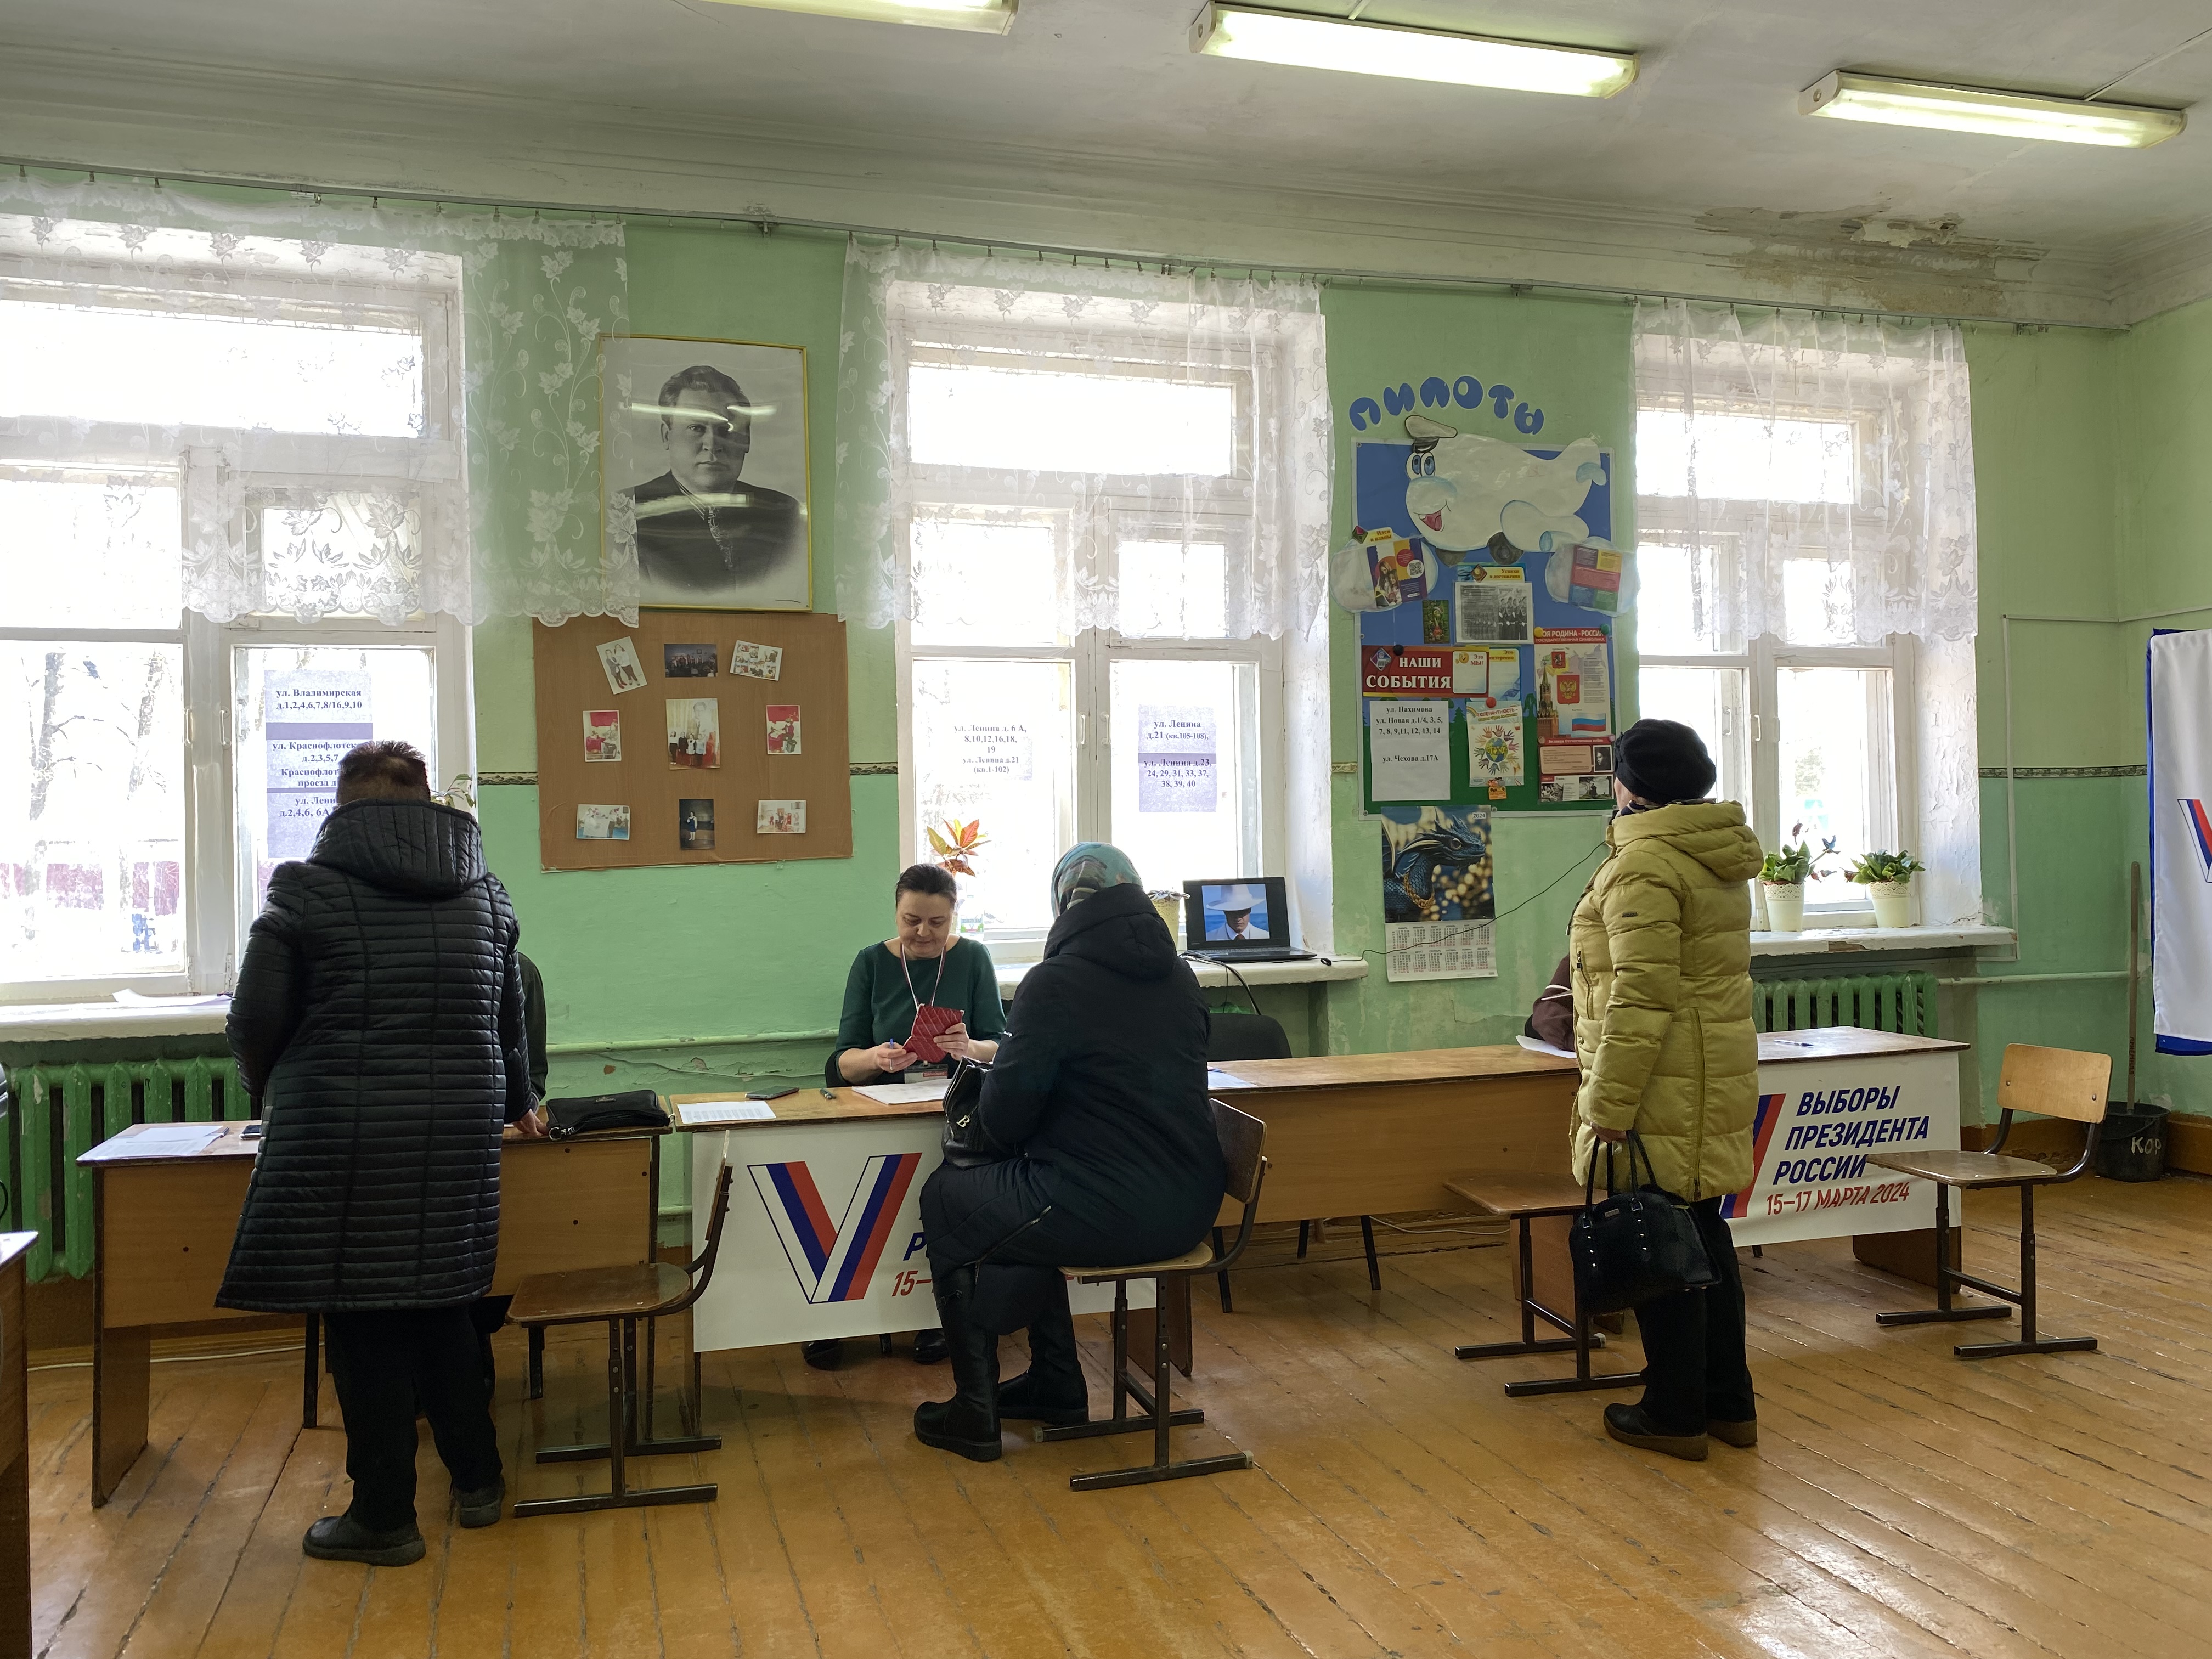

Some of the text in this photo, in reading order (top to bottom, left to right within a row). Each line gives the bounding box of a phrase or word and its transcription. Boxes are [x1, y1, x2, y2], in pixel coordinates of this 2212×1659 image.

[1348, 375, 1544, 435] ПИЛОТЫ
[1399, 657, 1441, 668] НАШИ
[1366, 675, 1451, 689] СОБЫТИЯ
[294, 689, 362, 698] Владимирская
[1147, 731, 1163, 740] д.21
[273, 742, 357, 752] ул. Краснофлотск
[1144, 760, 1156, 768] ул.
[281, 768, 338, 777] Краснофлот
[1198, 770, 1209, 778] 37,
[295, 798, 309, 806] ул.
[1796, 1085, 1901, 1116] ВЫБОРЫ
[1784, 1116, 1930, 1151] ПРЕЗИДЕНТА
[1773, 1154, 1869, 1186] РОССИИ
[1814, 1185, 1870, 1210] МАРТА
[1870, 1181, 1910, 1204] 2024
